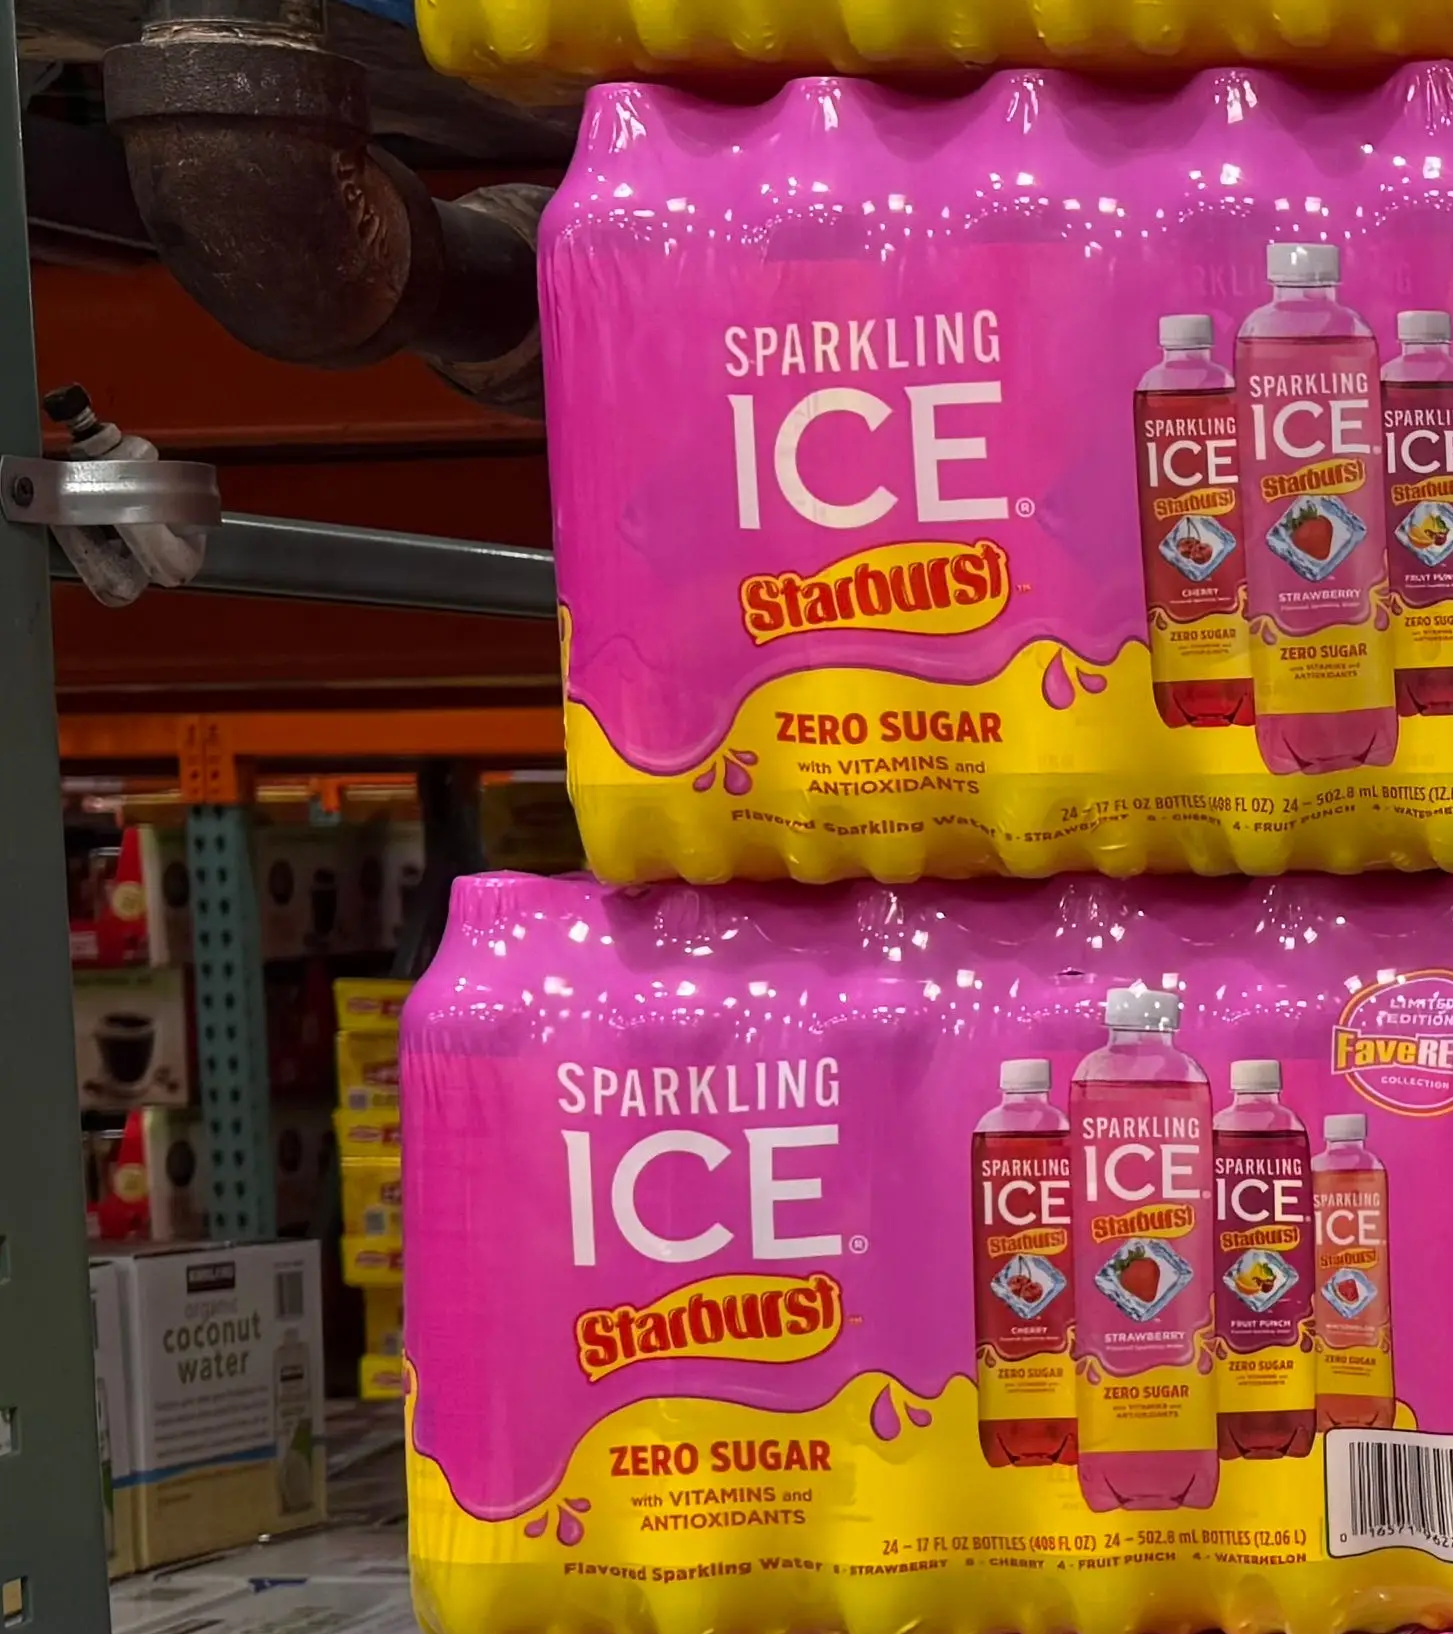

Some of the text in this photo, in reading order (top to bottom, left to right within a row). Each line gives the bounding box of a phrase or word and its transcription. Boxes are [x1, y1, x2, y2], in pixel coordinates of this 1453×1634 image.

[725, 310, 999, 376] SPARKLING
[745, 544, 1008, 639] Starburst
[776, 711, 1002, 744] ZERO SUGAR
[800, 755, 985, 775] with VITAMINS and
[809, 776, 979, 796] ANTIOXIDANTS
[558, 1058, 838, 1116] SPARKLING
[163, 1311, 261, 1353] coconut
[580, 1276, 840, 1367] Starburst
[177, 1351, 249, 1384] water
[610, 1440, 831, 1476] ZERO SUGAR
[632, 1487, 812, 1508] with VITAMINS and
[641, 1509, 806, 1530] ANTIOXIDANTS
